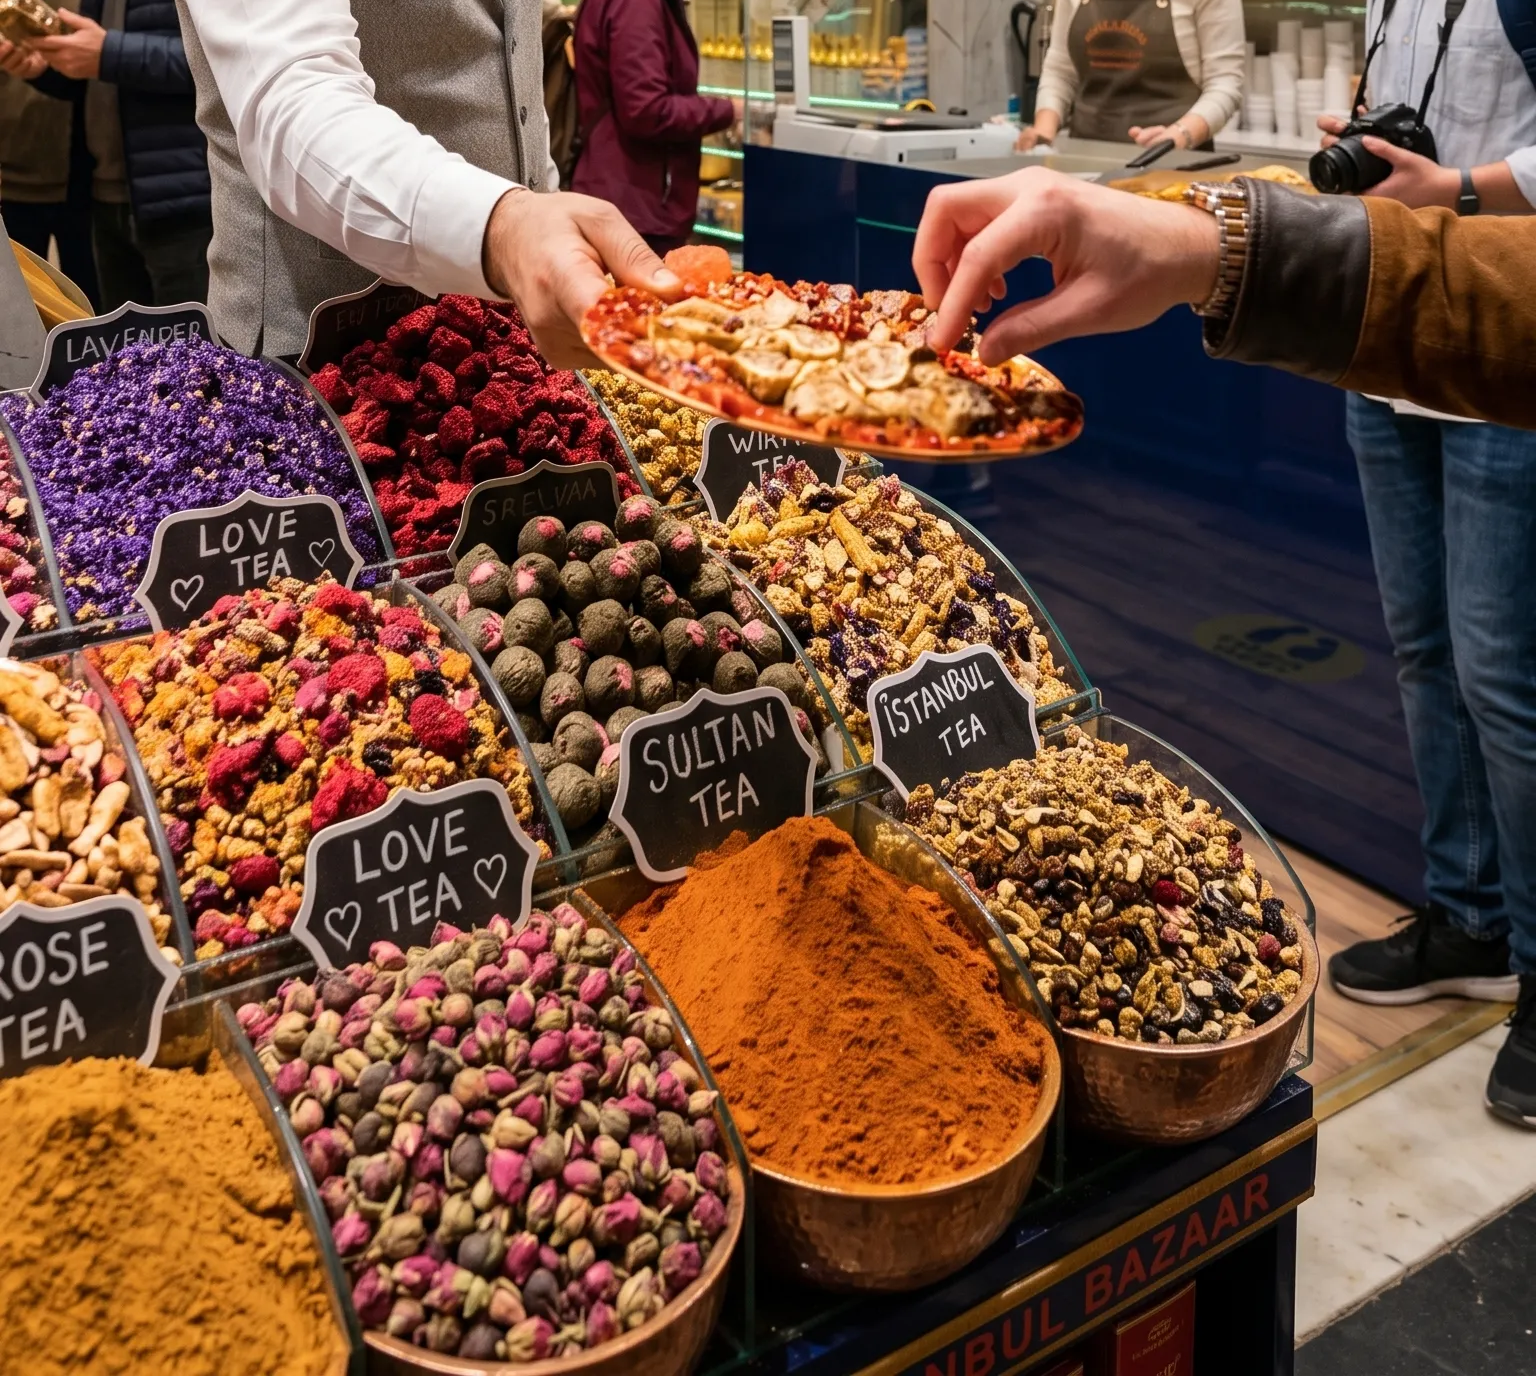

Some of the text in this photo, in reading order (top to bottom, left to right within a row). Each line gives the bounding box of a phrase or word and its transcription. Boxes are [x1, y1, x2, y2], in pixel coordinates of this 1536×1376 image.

[199, 508, 298, 559] LOVE
[229, 551, 292, 588] TEA
[642, 702, 777, 795] SULTAN
[937, 713, 987, 757] TEA
[689, 772, 761, 828] TEA
[352, 808, 470, 884] LOVE
[376, 873, 463, 928] TEA
[1084, 1172, 1272, 1316] BAZAAR
